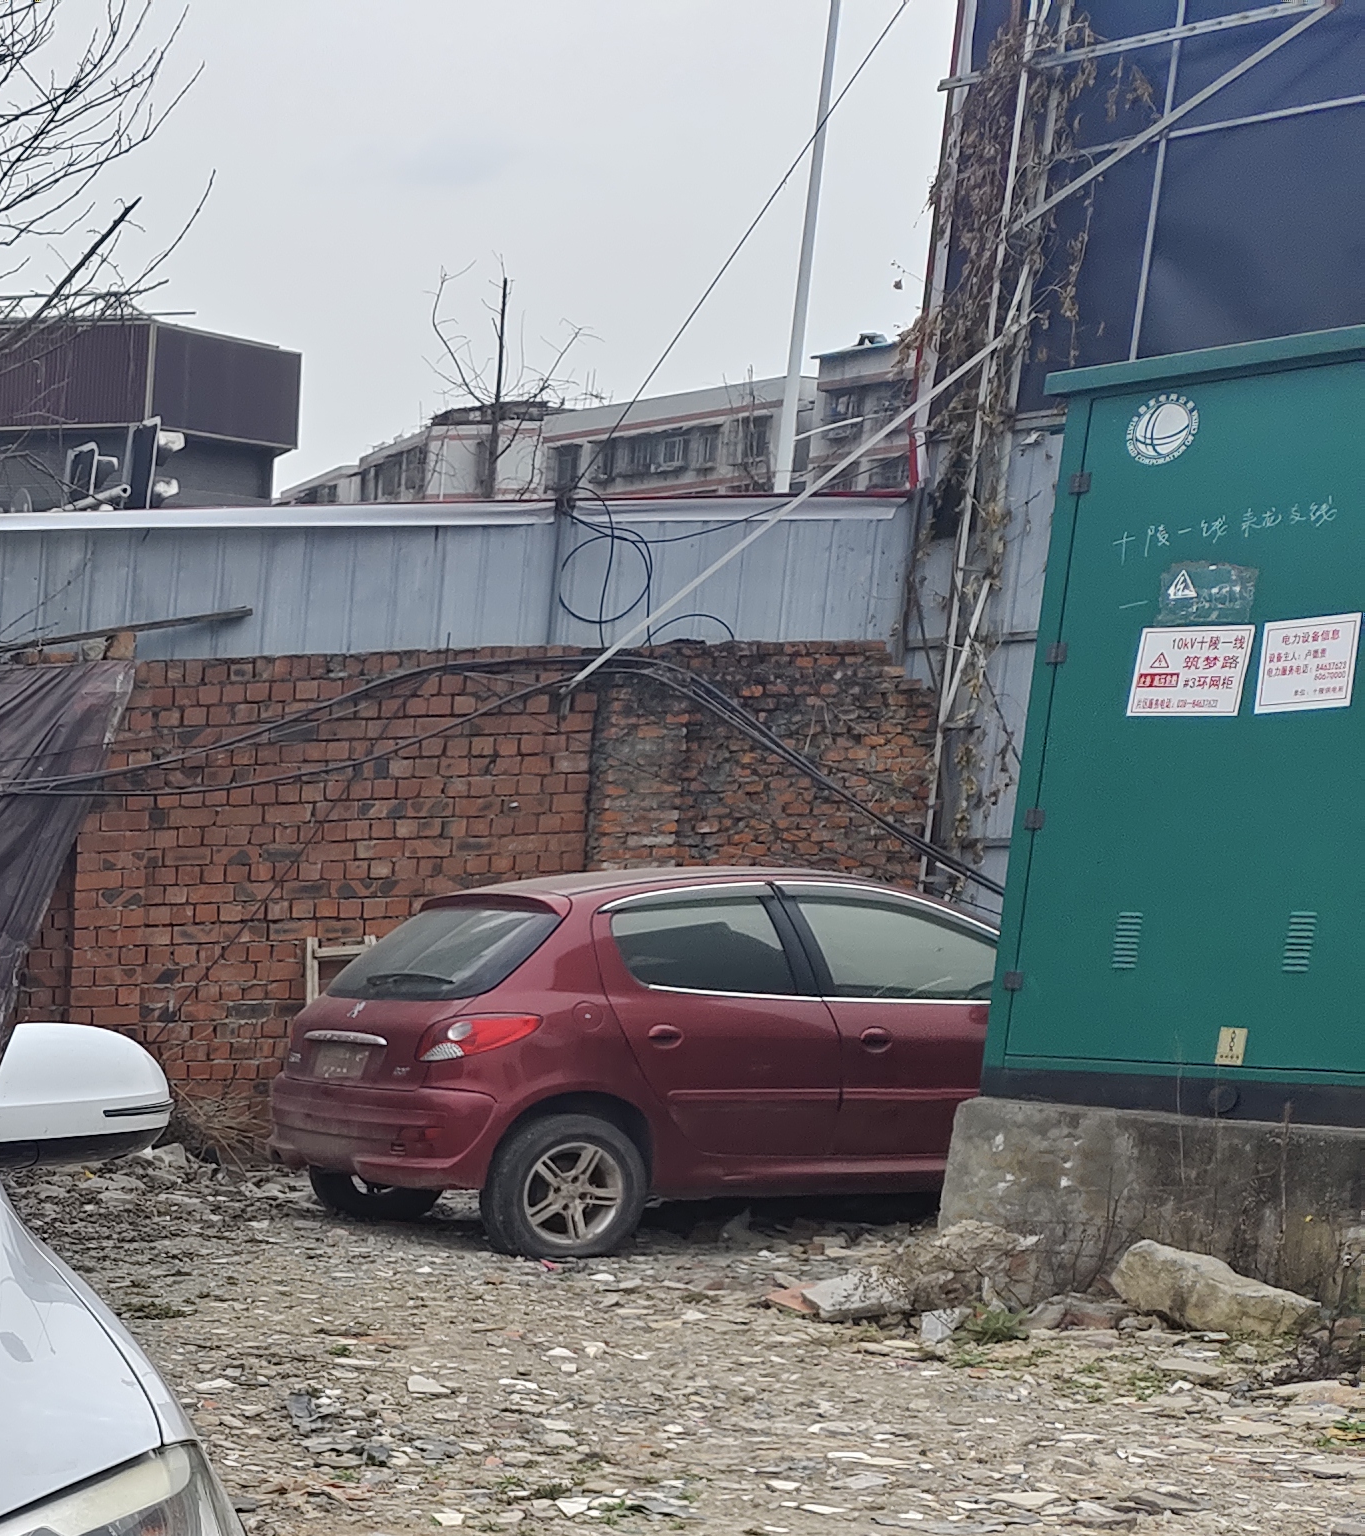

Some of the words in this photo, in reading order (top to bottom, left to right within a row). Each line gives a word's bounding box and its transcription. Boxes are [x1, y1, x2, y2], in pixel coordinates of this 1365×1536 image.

[1172, 635, 1246, 651] 10kV十陵一线
[1281, 628, 1340, 646] 电力设备信息
[1182, 655, 1240, 670] 筑梦路
[1182, 675, 1235, 690] #3环网柜
